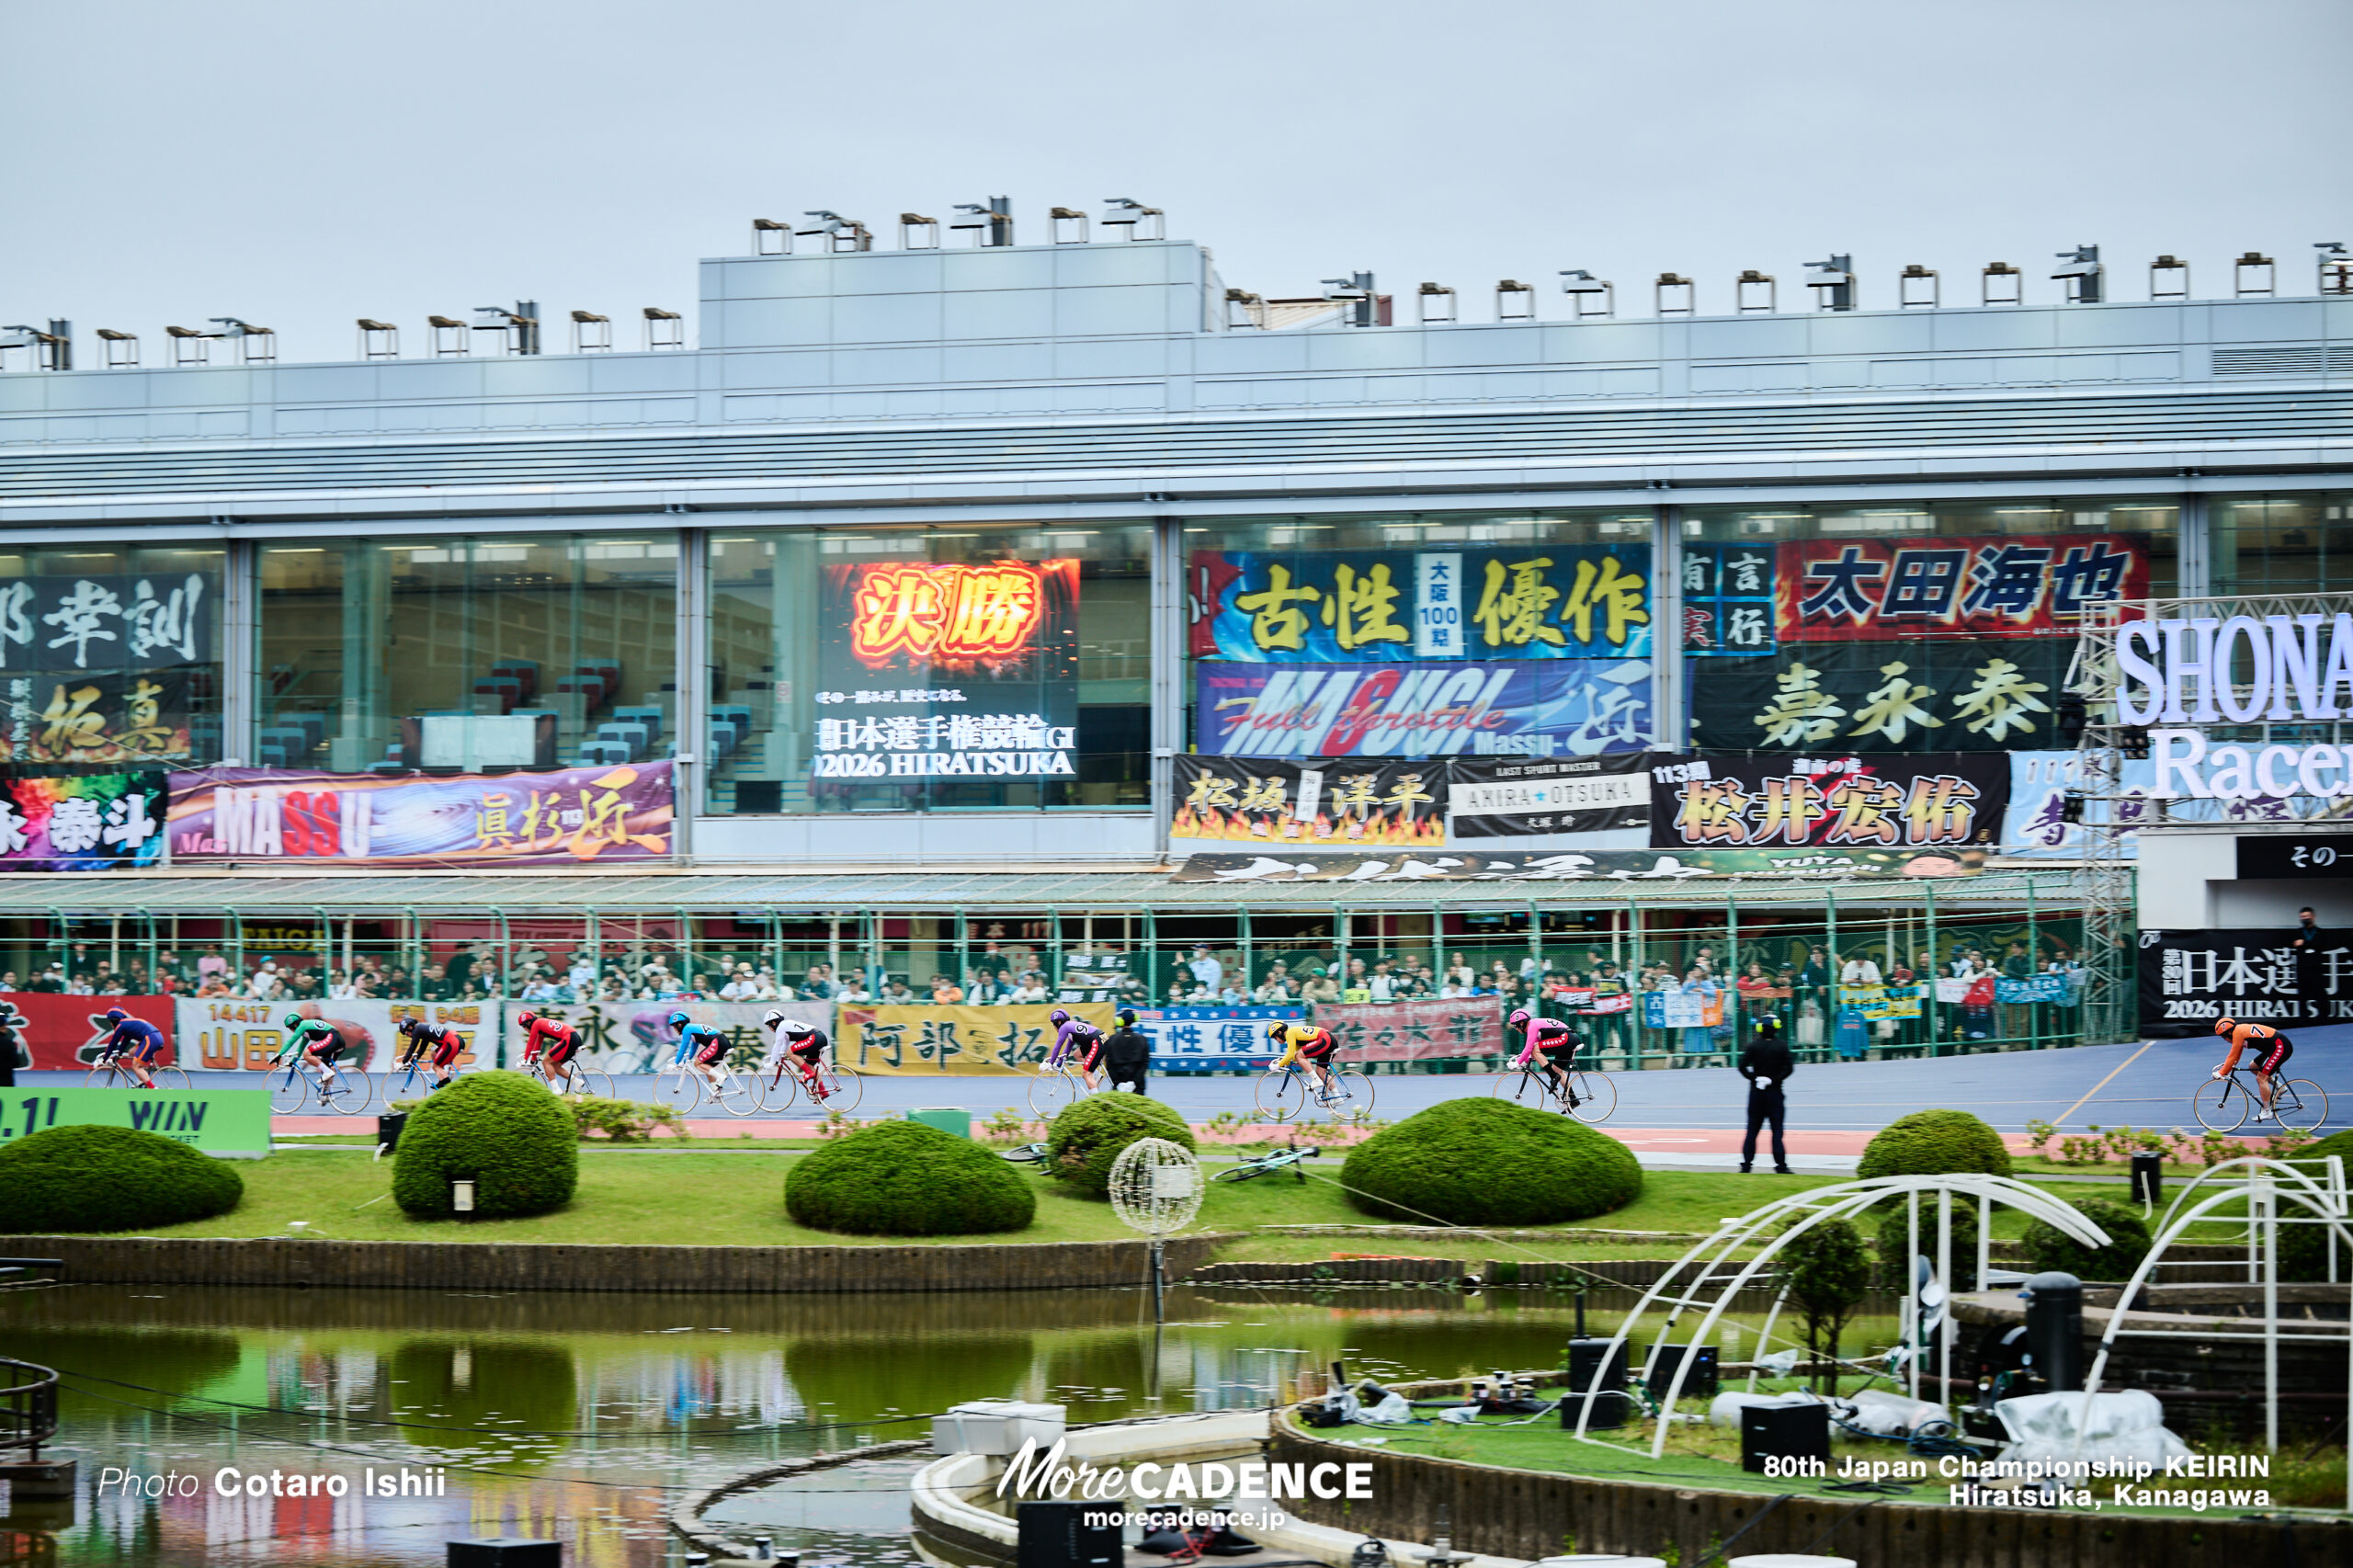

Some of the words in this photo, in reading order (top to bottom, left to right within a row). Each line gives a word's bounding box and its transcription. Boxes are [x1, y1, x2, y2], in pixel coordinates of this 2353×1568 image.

[1799, 541, 2132, 618] 太田海也
[852, 567, 1041, 655] 決勝
[1213, 696, 1323, 736] Full
[1336, 696, 1509, 733] throttle
[824, 754, 886, 778] 2026
[888, 751, 1076, 777] HIRATSUKA
[1468, 788, 1532, 809] AKIRA
[1552, 781, 1632, 804] OTSUKA
[1673, 775, 1982, 846] 松井宏佑
[213, 787, 372, 857] MASSU
[1769, 856, 1854, 869] YUYA
[2164, 1000, 2220, 1018] 2026
[313, 1020, 326, 1030] 6
[429, 1024, 444, 1038] 2
[549, 1020, 563, 1031] 3
[701, 1024, 712, 1036] 4
[1074, 1024, 1089, 1037] 9
[1302, 1026, 1315, 1036] 5
[2250, 1025, 2266, 1039] 7
[129, 1100, 209, 1131] WIN
